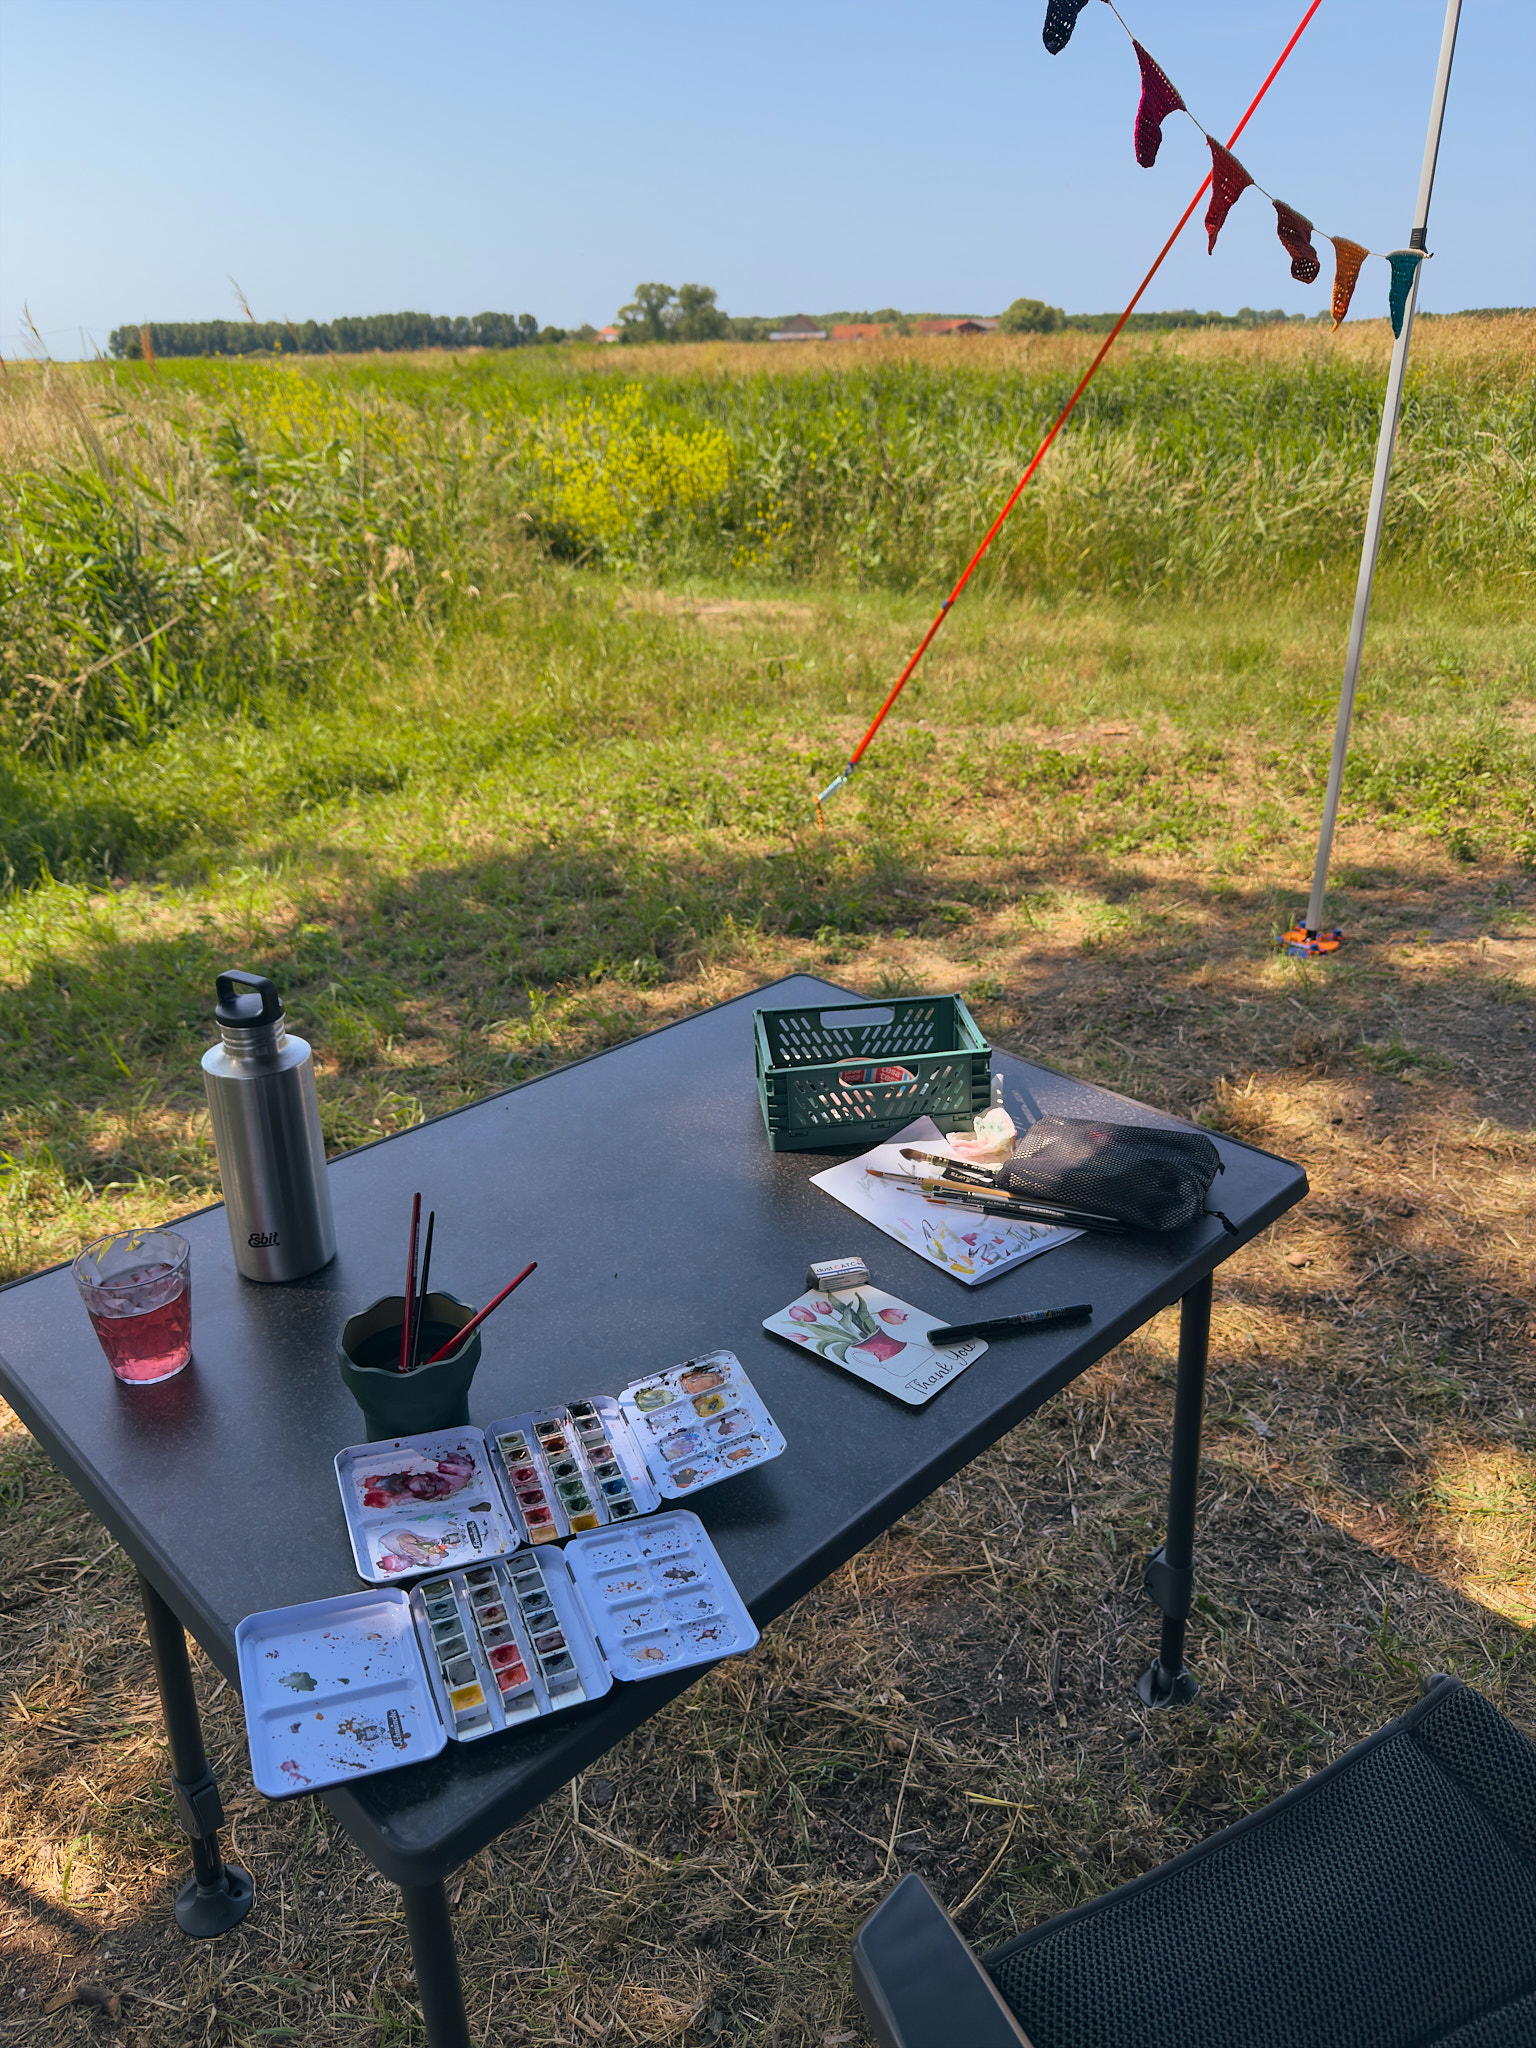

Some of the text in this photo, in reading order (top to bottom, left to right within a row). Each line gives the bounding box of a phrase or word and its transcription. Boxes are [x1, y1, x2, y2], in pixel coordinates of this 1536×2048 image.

[248, 1232, 280, 1248] Esbit
[905, 1343, 976, 1395] Thank You
